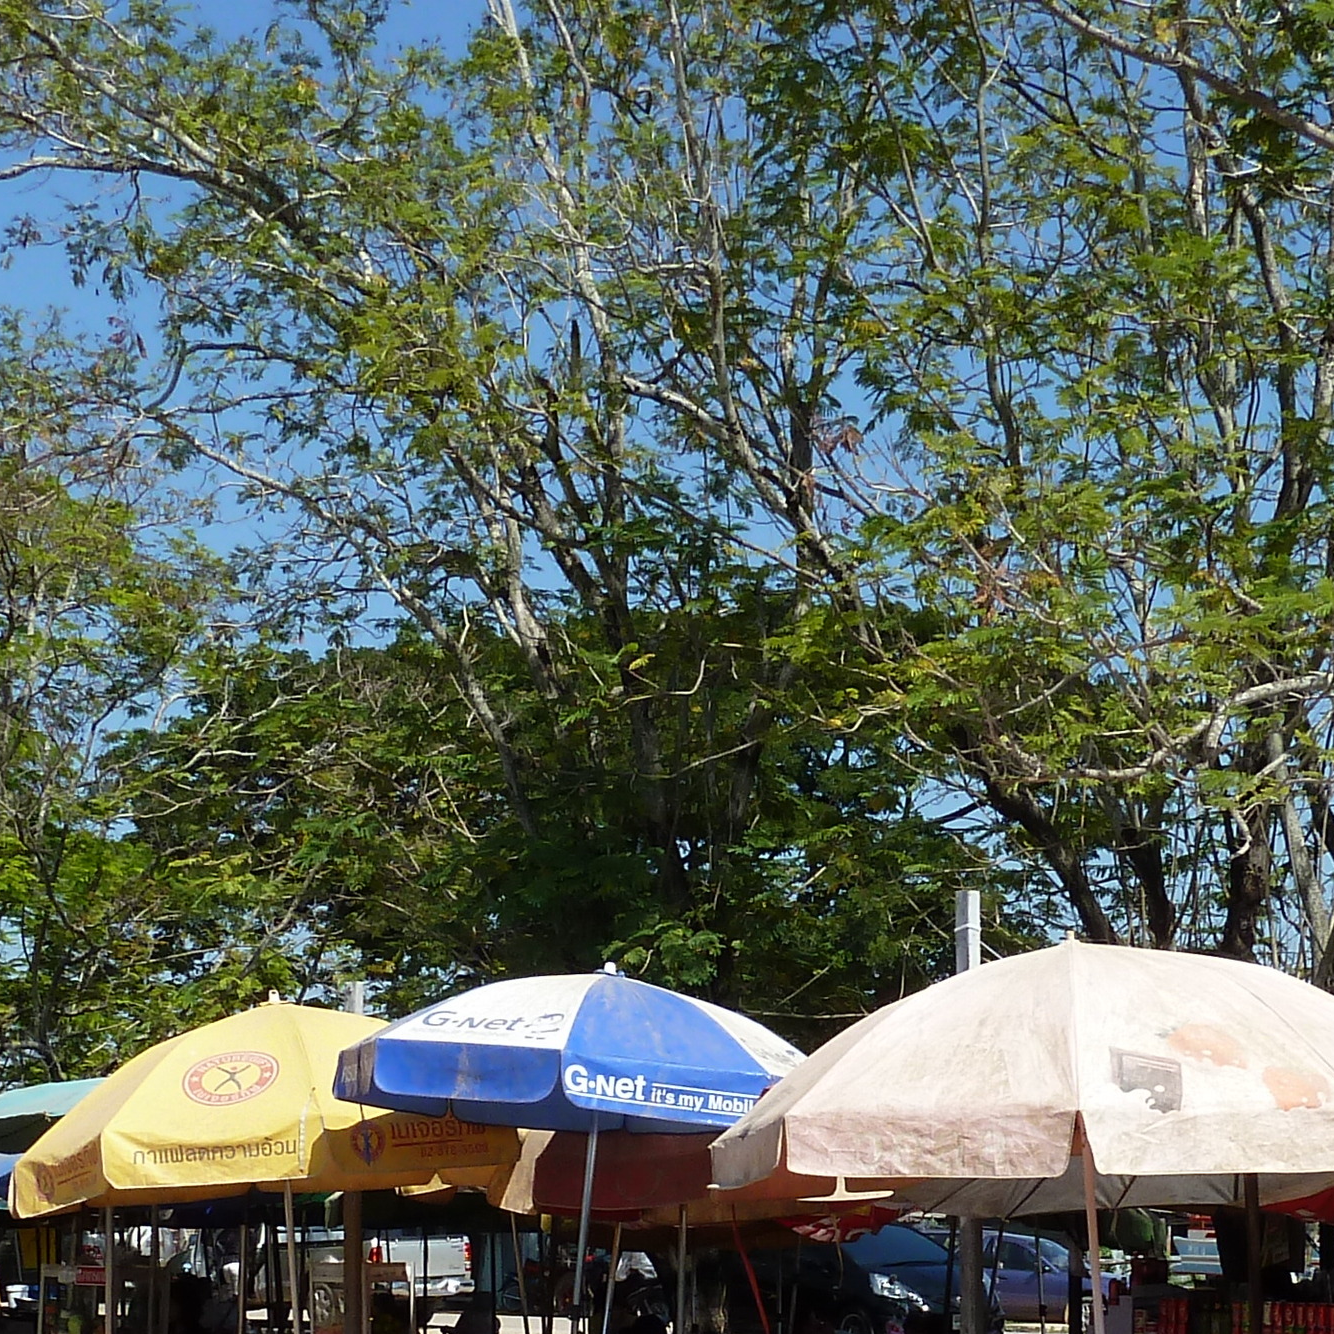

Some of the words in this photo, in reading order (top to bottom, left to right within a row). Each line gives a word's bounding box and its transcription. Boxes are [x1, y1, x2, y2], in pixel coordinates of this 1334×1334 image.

[651, 1087, 676, 1106] it's
[678, 1093, 704, 1112] my
[708, 1095, 756, 1114] Mobil
[132, 1136, 297, 1165] กาแฟลดความอ้วน
